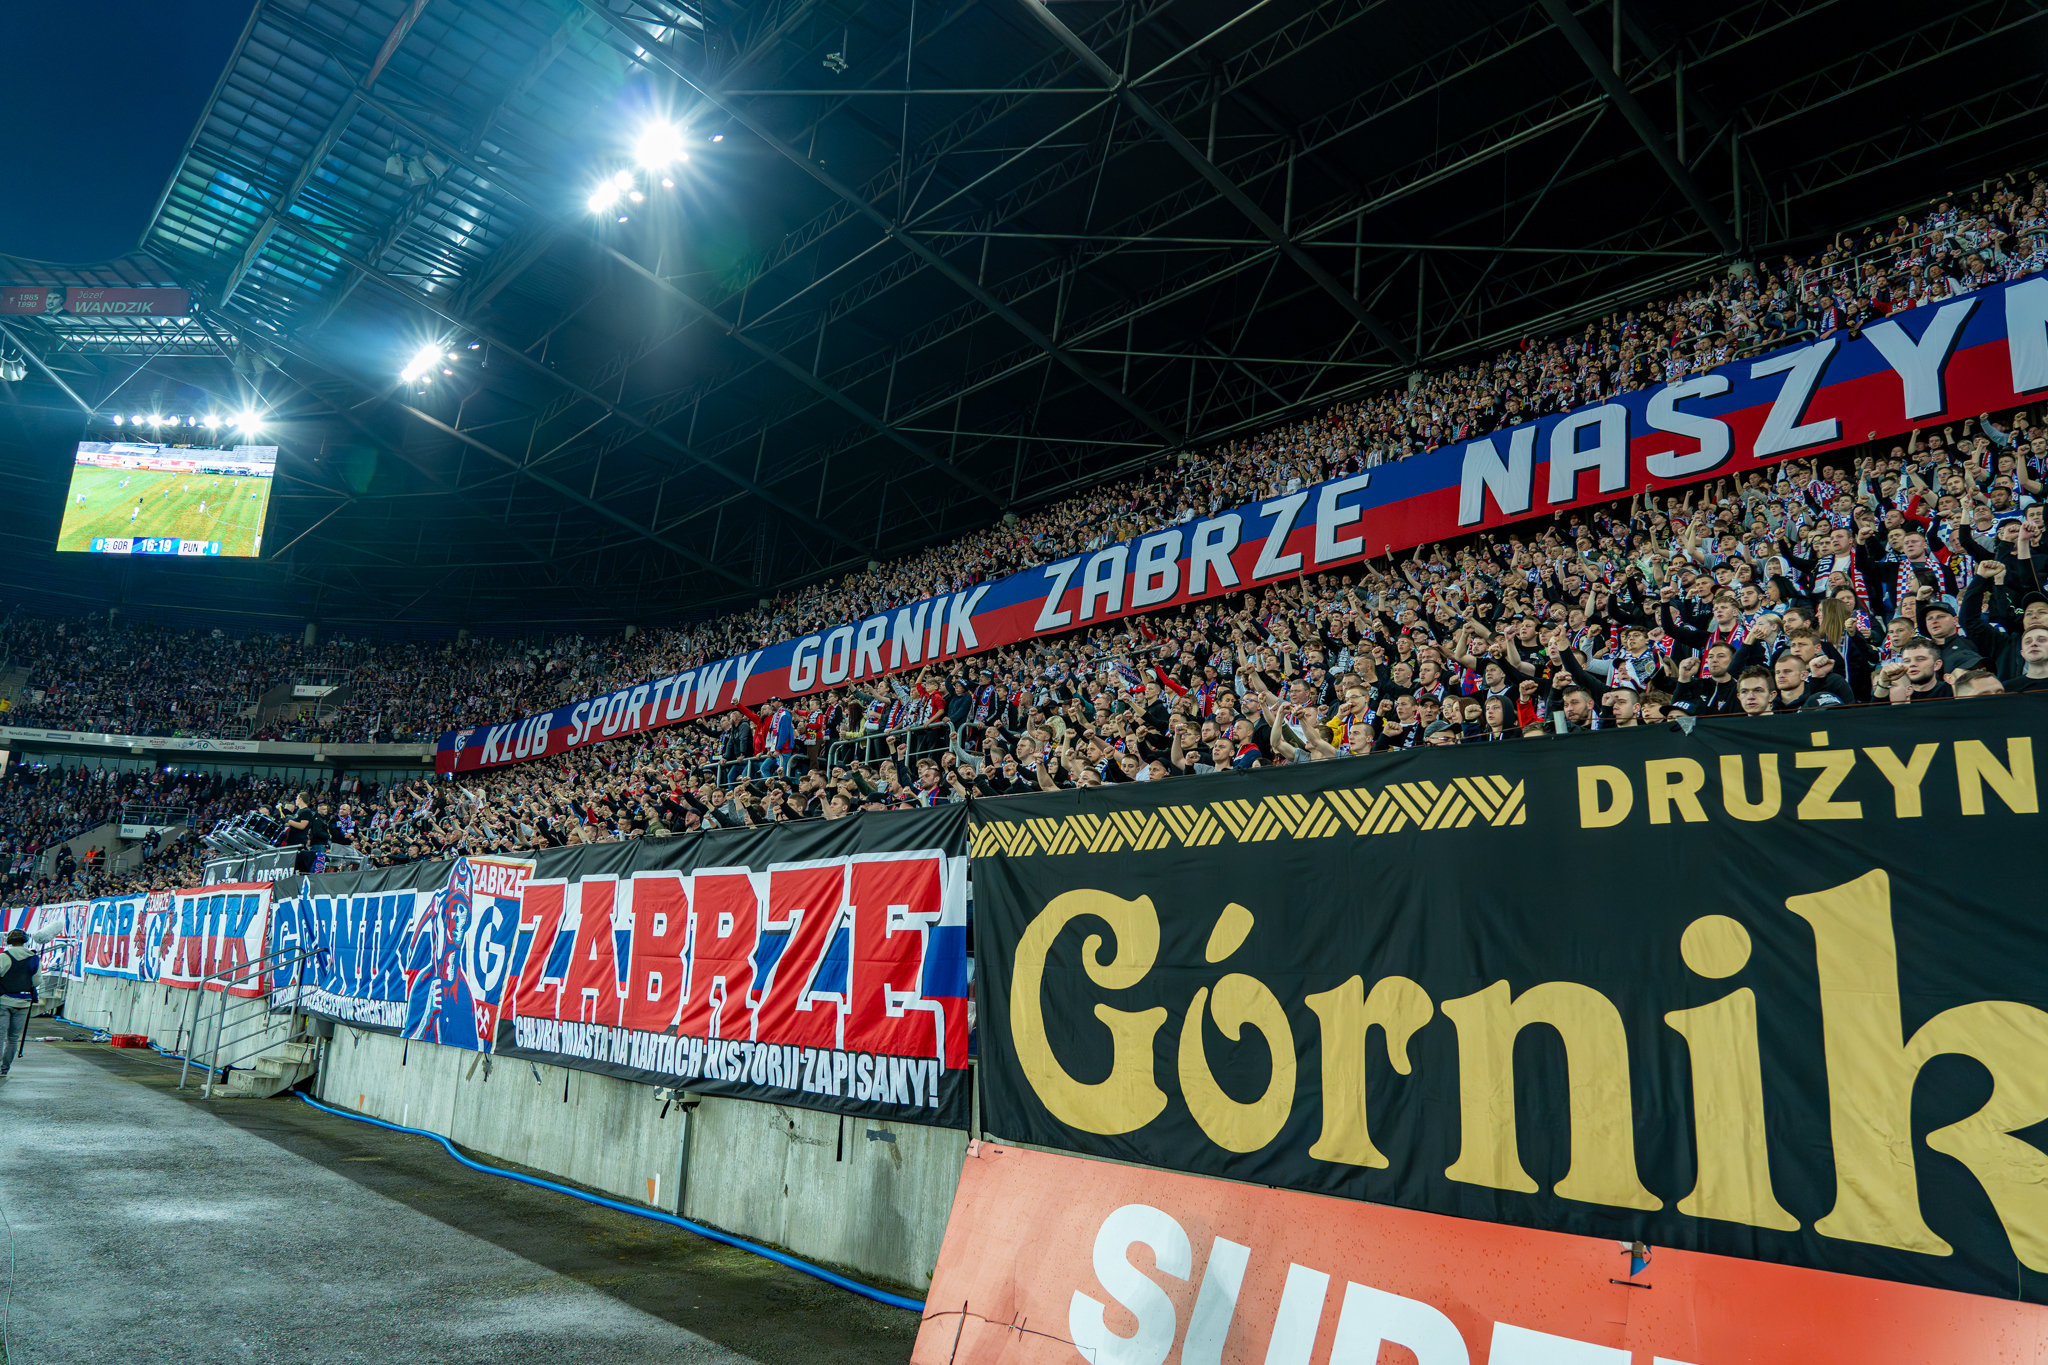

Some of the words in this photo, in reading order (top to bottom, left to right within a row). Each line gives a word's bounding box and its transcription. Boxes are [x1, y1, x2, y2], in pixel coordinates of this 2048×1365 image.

[19, 293, 39, 301] 1985
[75, 301, 154, 314] WANDZIK
[77, 290, 104, 300] Józef
[112, 540, 128, 551] GOR
[141, 538, 172, 553] 16:19
[182, 542, 199, 553] PUN
[480, 712, 554, 765] KLUB
[567, 650, 764, 747] SPORTOWY
[1034, 474, 1371, 634] ZABRZE
[1580, 731, 2038, 829] DRUŻYN
[472, 863, 526, 898] ZABRZE
[172, 894, 260, 995] NIK
[513, 848, 948, 1076] ZABRZE
[803, 1048, 939, 1108] ZAPISANY!
[1011, 868, 2048, 1275] Górnik
